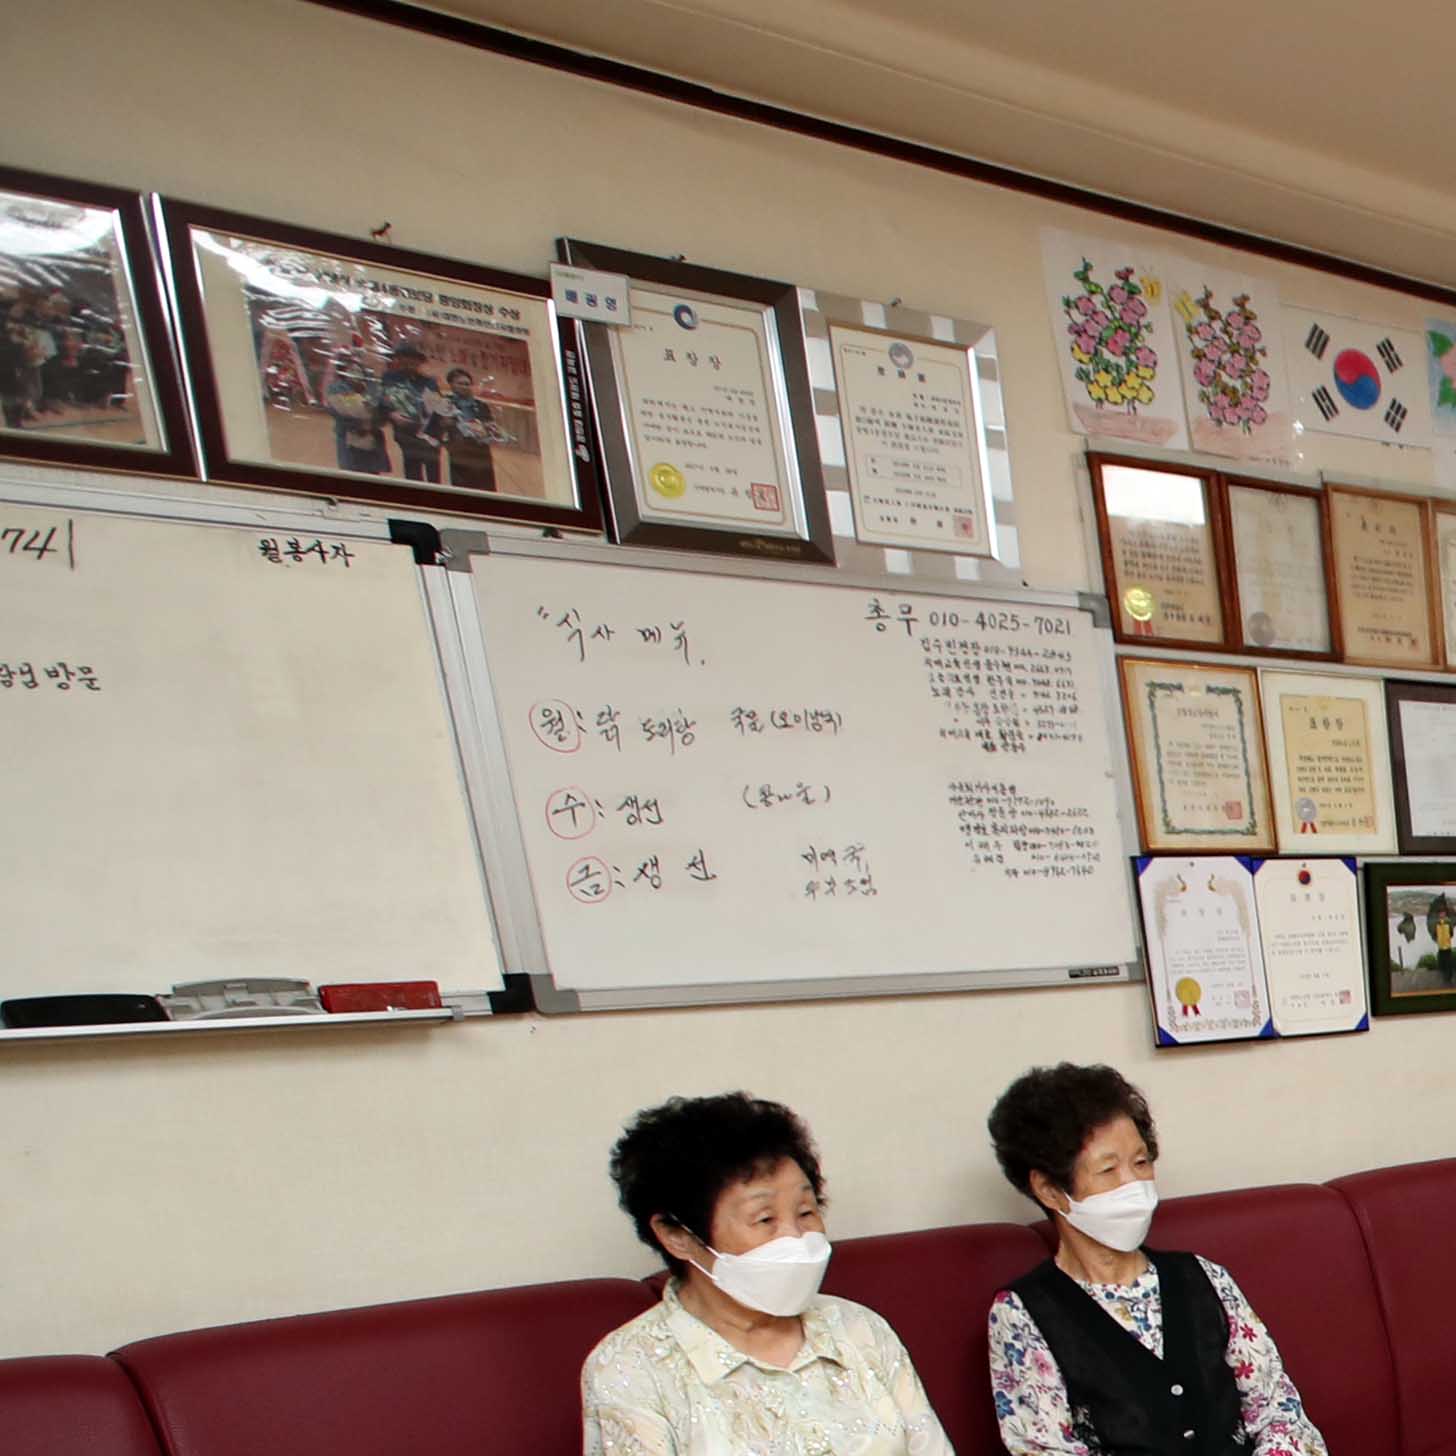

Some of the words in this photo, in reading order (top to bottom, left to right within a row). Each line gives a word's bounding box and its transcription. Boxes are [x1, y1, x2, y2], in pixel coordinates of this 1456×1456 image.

[928, 610, 1072, 635] 010-4025-7021
[44, 661, 102, 692] 방문
[616, 793, 664, 826] 생선
